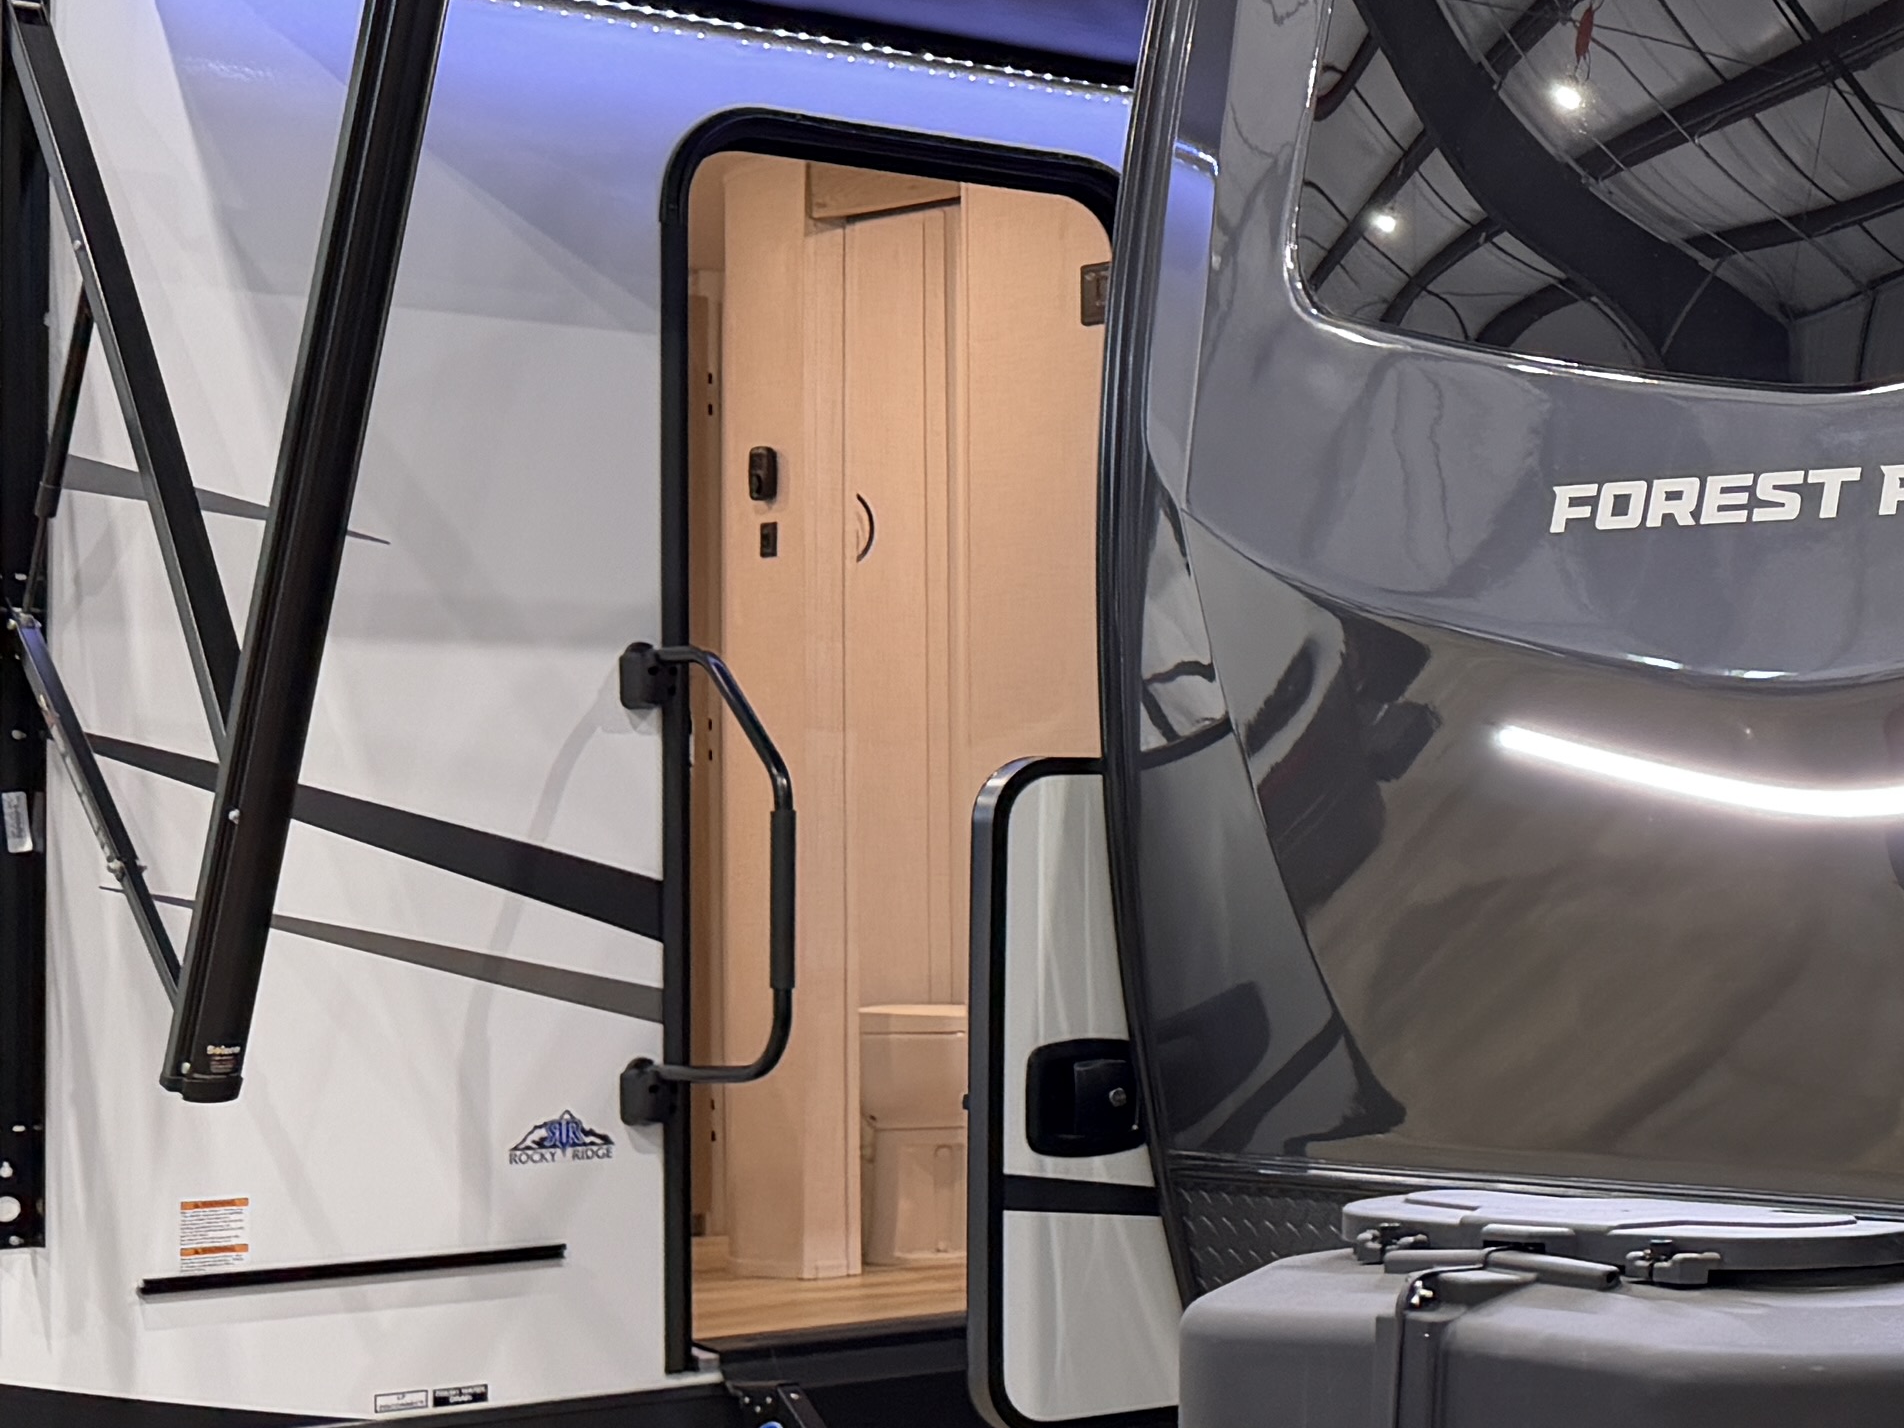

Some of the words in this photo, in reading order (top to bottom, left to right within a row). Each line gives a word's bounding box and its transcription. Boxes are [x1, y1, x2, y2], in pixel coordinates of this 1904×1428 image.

[1549, 466, 1862, 534] FOREST
[509, 1151, 557, 1165] ROCKY
[572, 1146, 613, 1161] RIDGE
